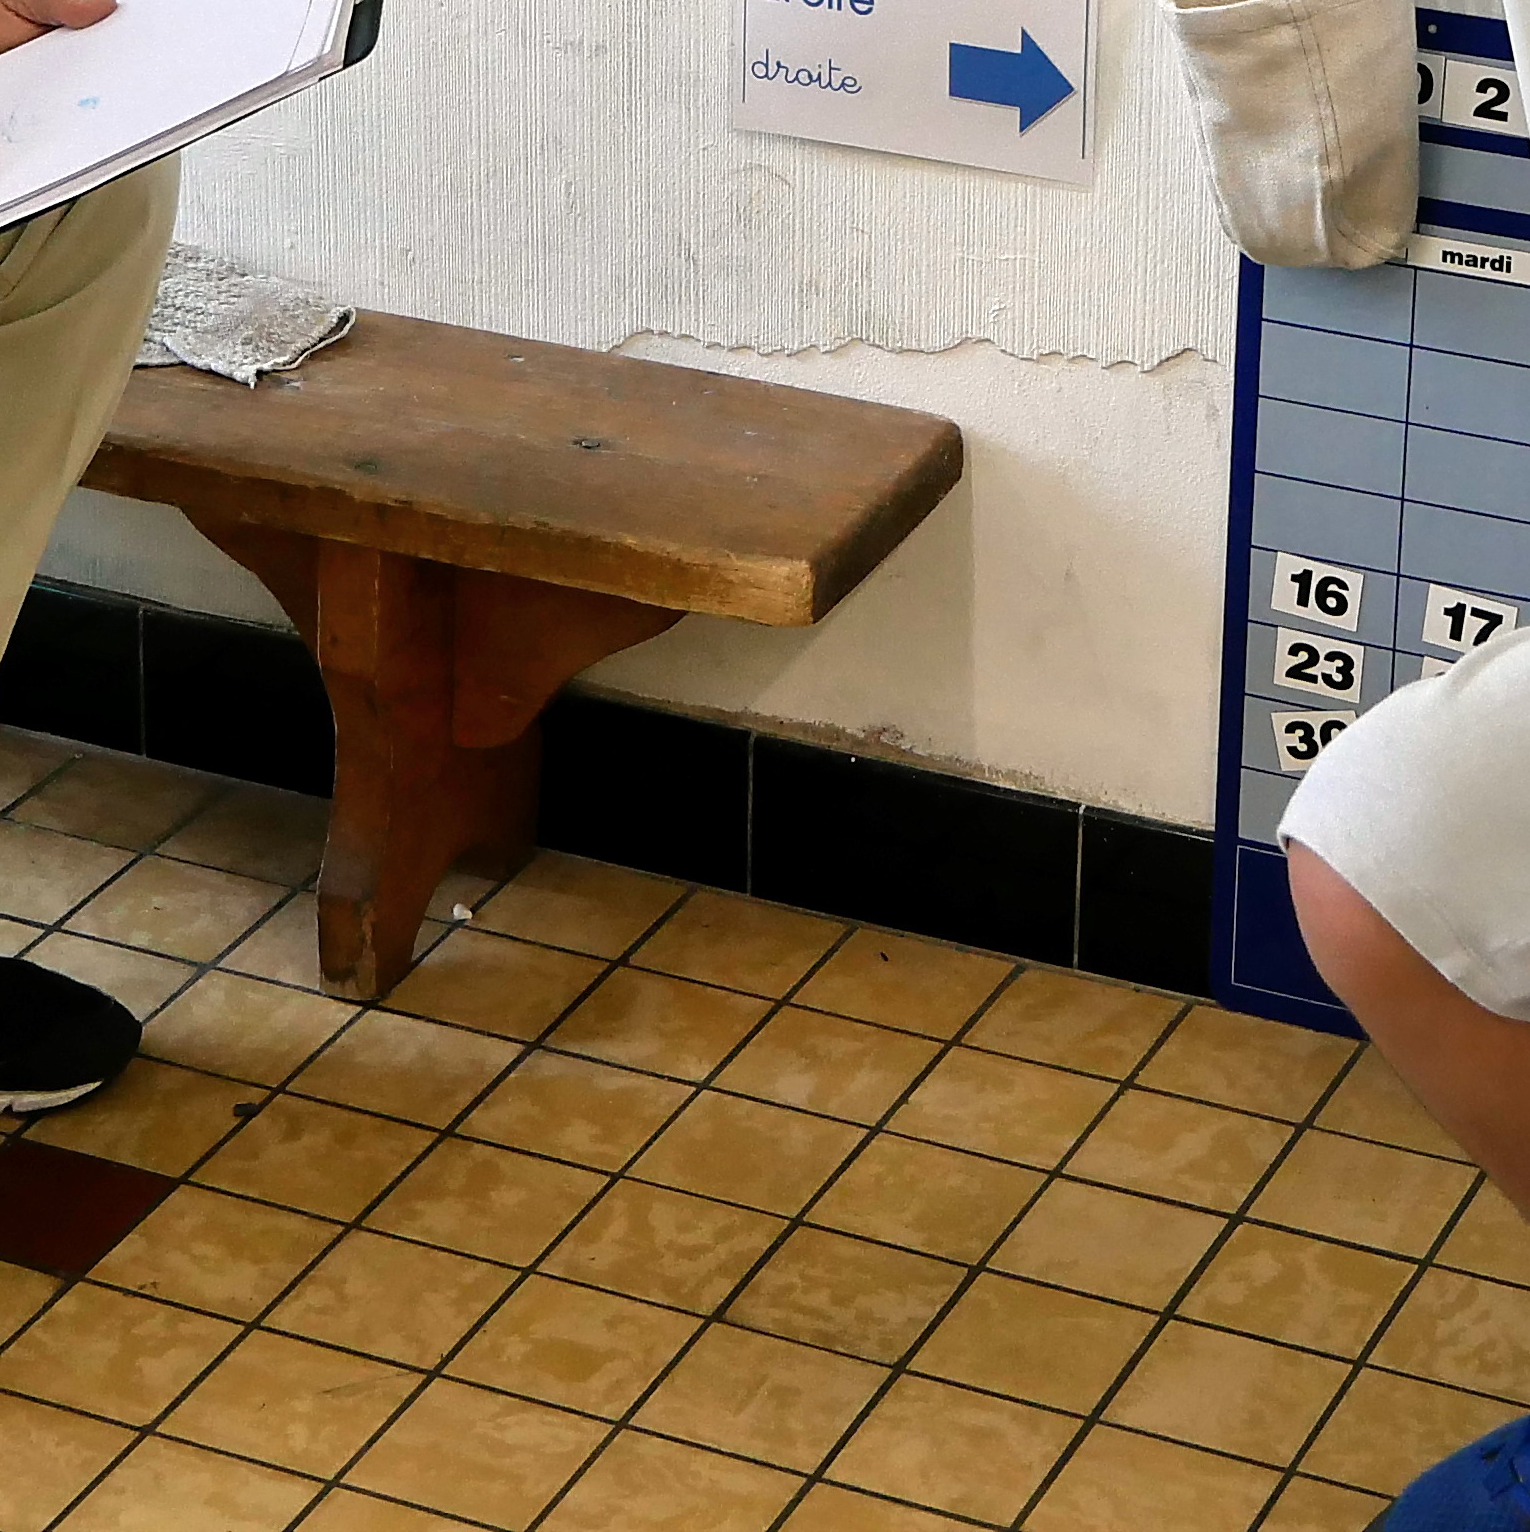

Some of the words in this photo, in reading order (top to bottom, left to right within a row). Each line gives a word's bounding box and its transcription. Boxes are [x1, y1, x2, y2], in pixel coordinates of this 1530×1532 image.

[750, 48, 863, 95] droite
[1440, 246, 1513, 276] mardi
[1289, 568, 1350, 617] 16
[1442, 602, 1504, 646] 17
[1284, 641, 1356, 691] 23
